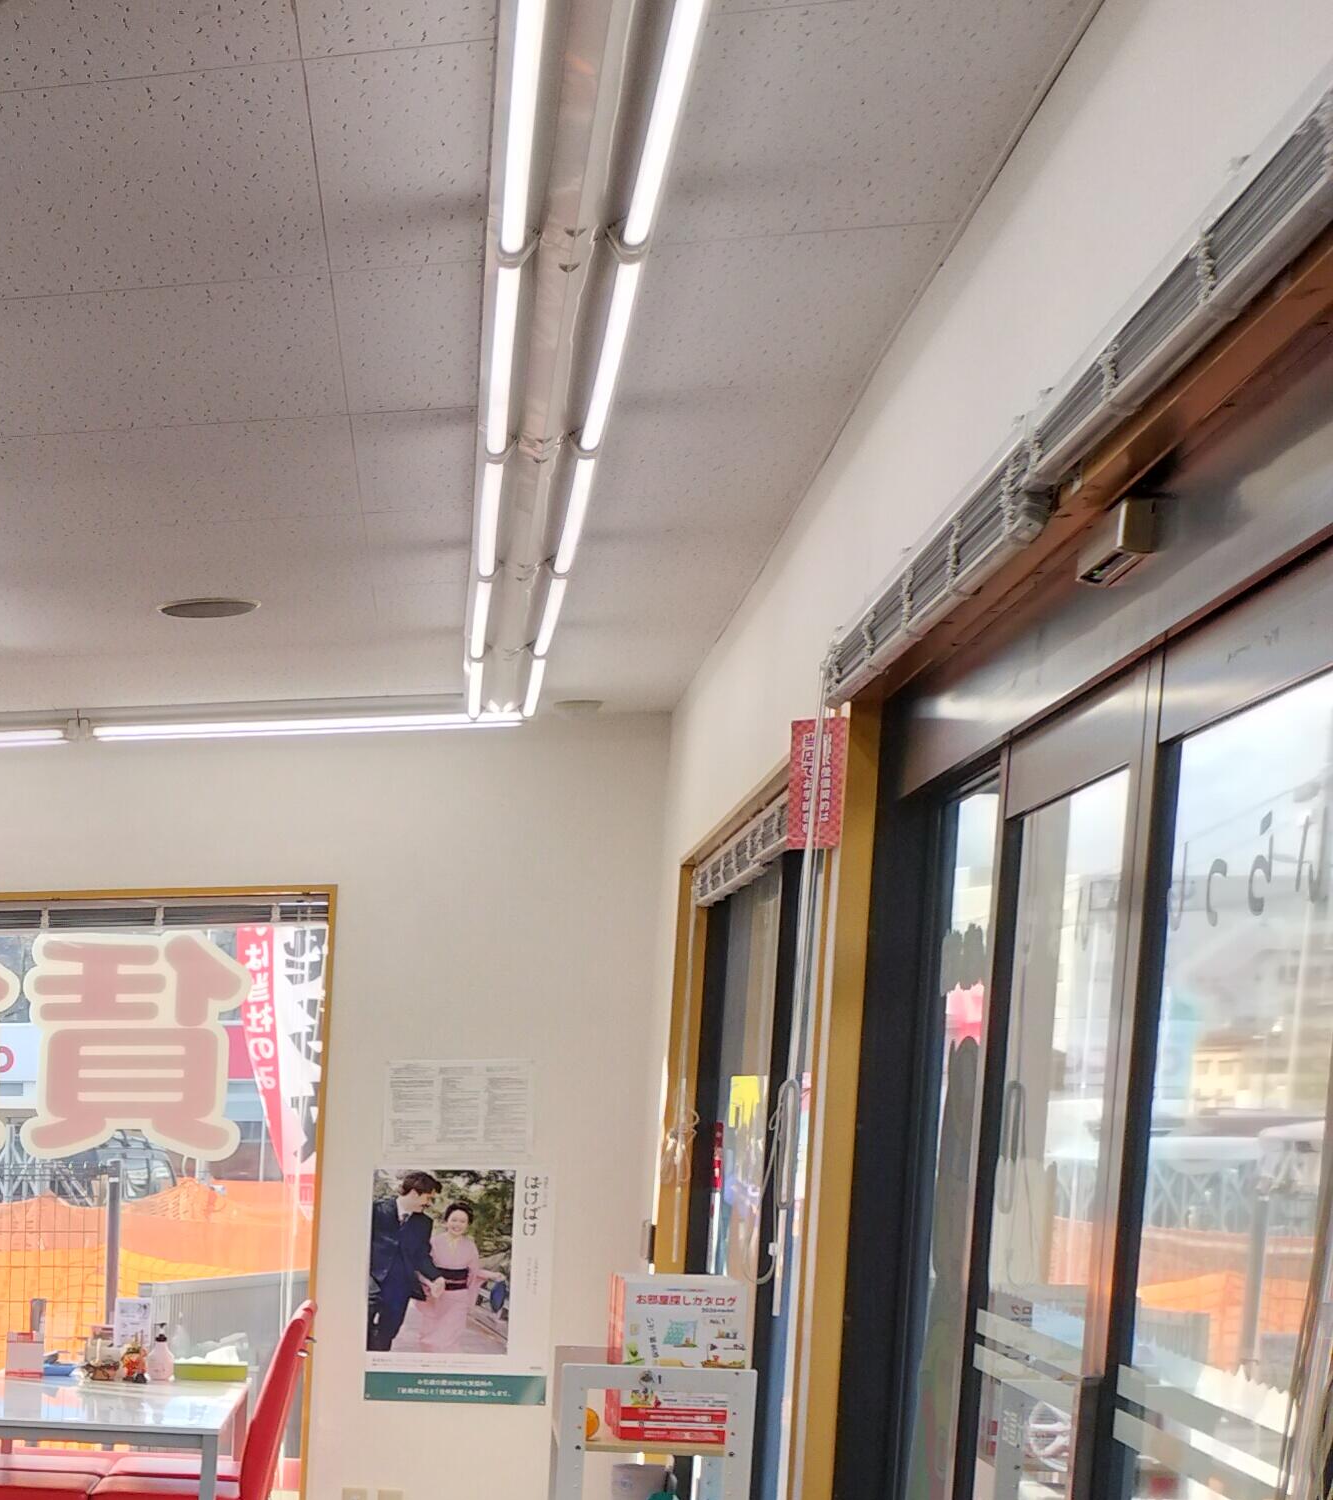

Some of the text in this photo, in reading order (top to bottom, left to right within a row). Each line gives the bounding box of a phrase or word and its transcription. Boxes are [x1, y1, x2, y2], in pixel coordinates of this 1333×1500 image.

[636, 1295, 737, 1306] お部屋探しカタログ
